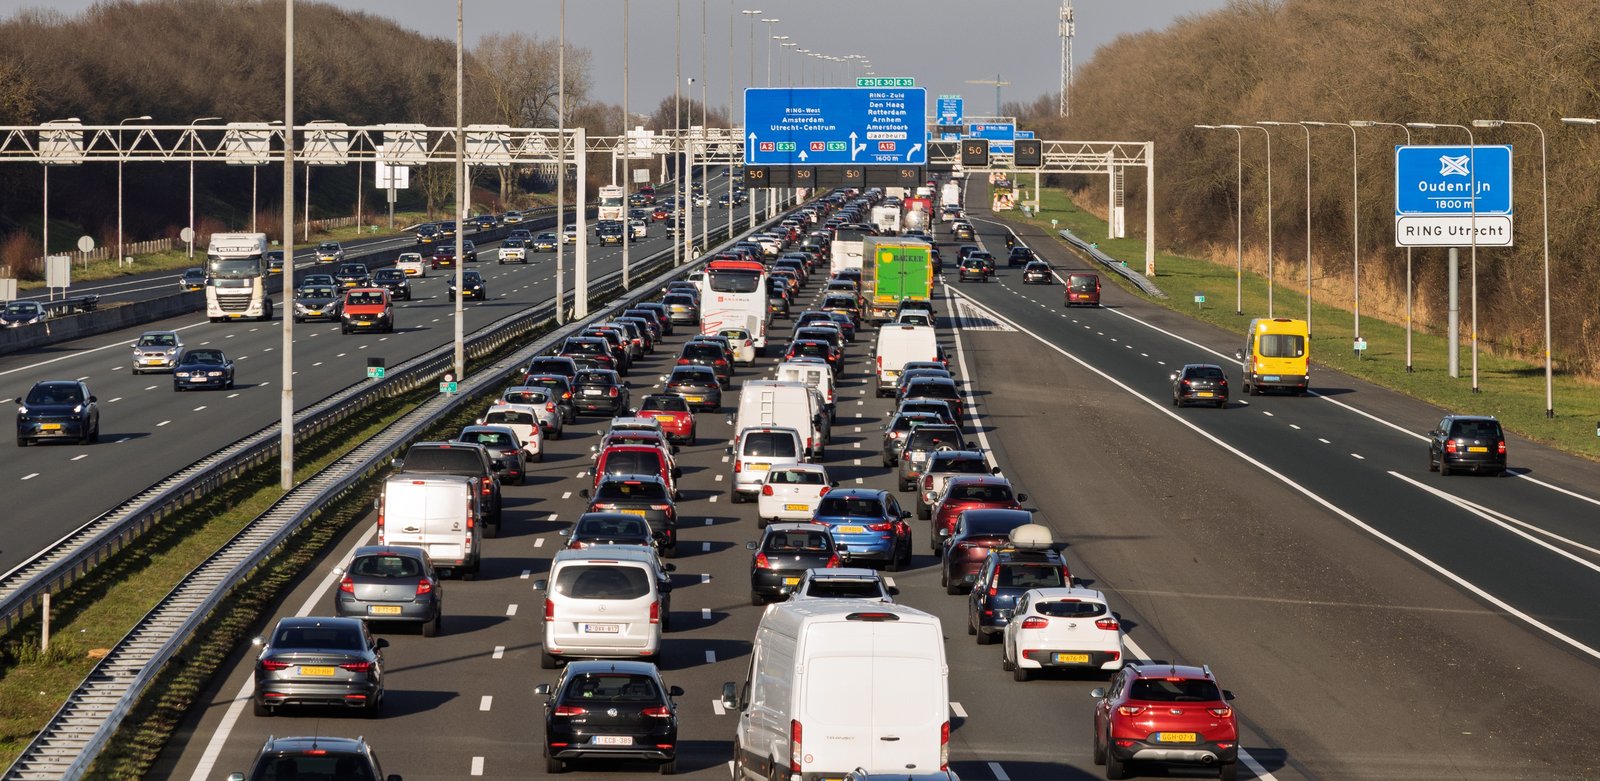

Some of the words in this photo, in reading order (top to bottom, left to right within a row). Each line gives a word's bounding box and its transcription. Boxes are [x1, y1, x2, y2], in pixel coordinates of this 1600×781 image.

[968, 146, 982, 155] 50
[749, 170, 763, 178] 50
[797, 170, 810, 178] 50
[846, 170, 860, 178] 50
[901, 170, 915, 178] 50
[1418, 181, 1491, 194] Oudenrjn
[1435, 200, 1462, 208] 1800
[1406, 226, 1442, 236] RING
[1448, 226, 1503, 236] Utrecht
